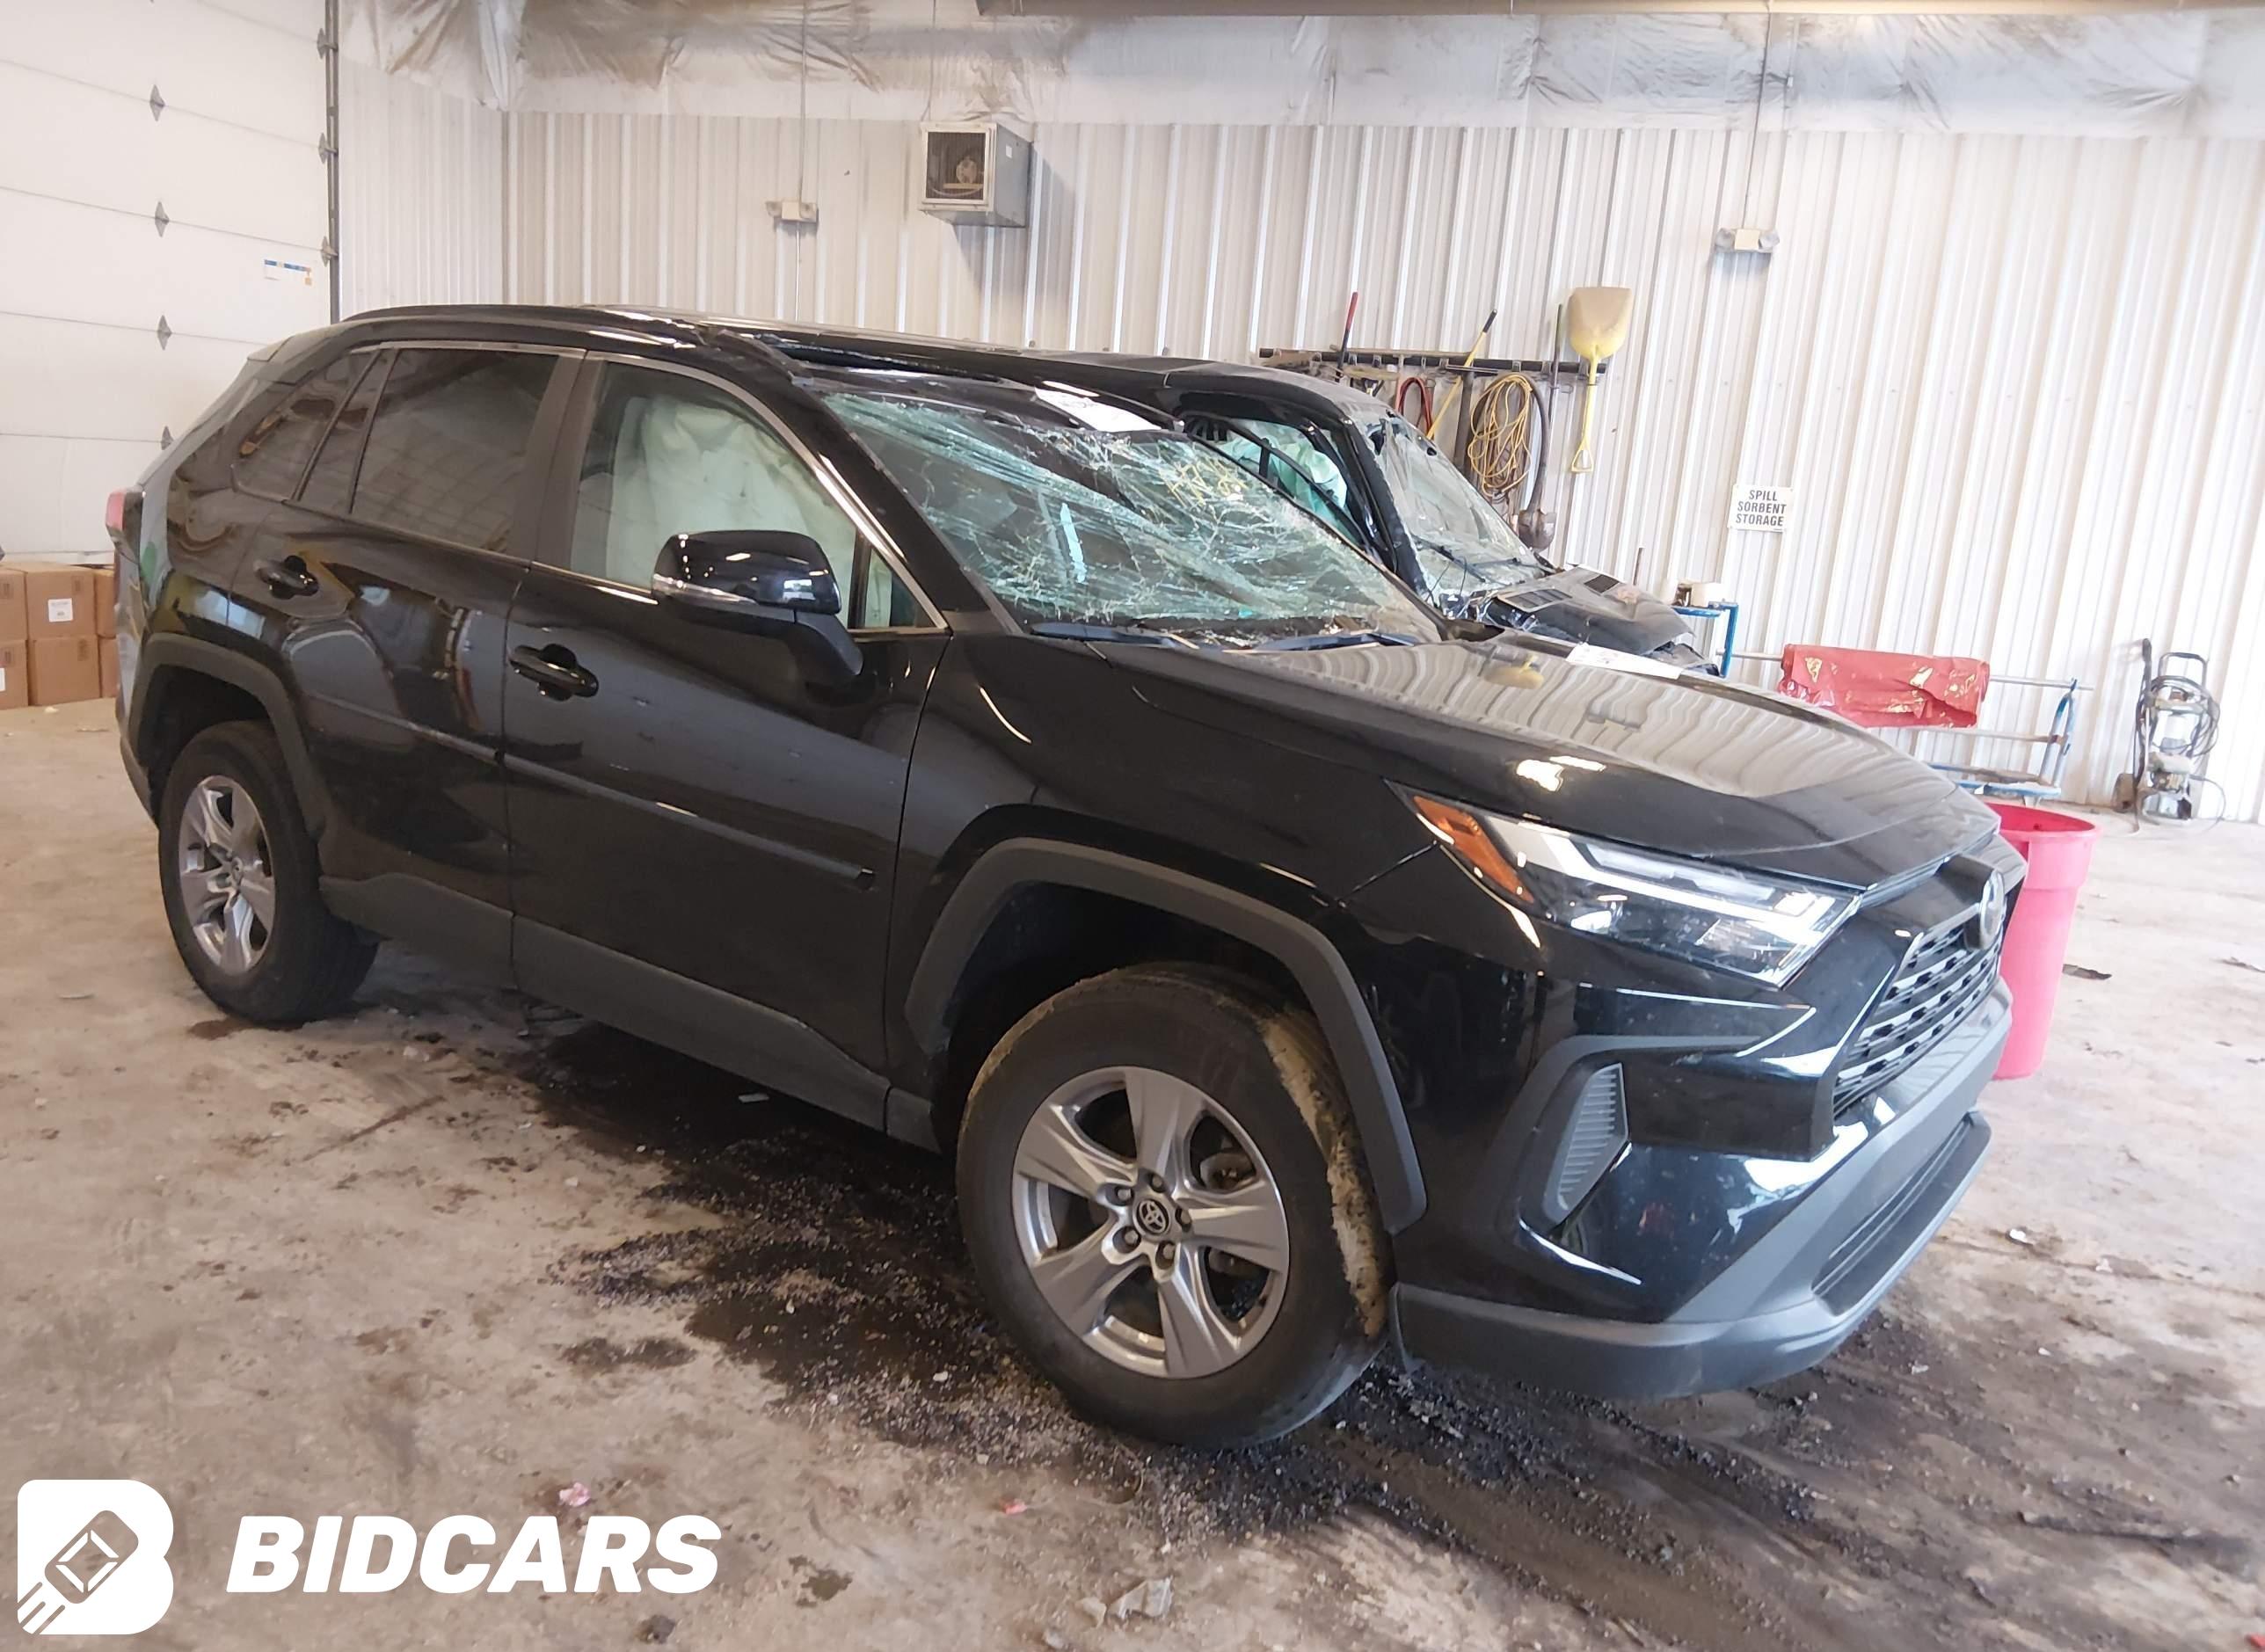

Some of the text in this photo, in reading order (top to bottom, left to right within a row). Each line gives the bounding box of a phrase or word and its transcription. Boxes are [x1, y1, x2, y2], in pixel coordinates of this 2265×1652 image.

[1749, 490, 1778, 501] SPILL
[1737, 501, 1787, 514] SORBENT
[1736, 513, 1784, 527] STORAGE
